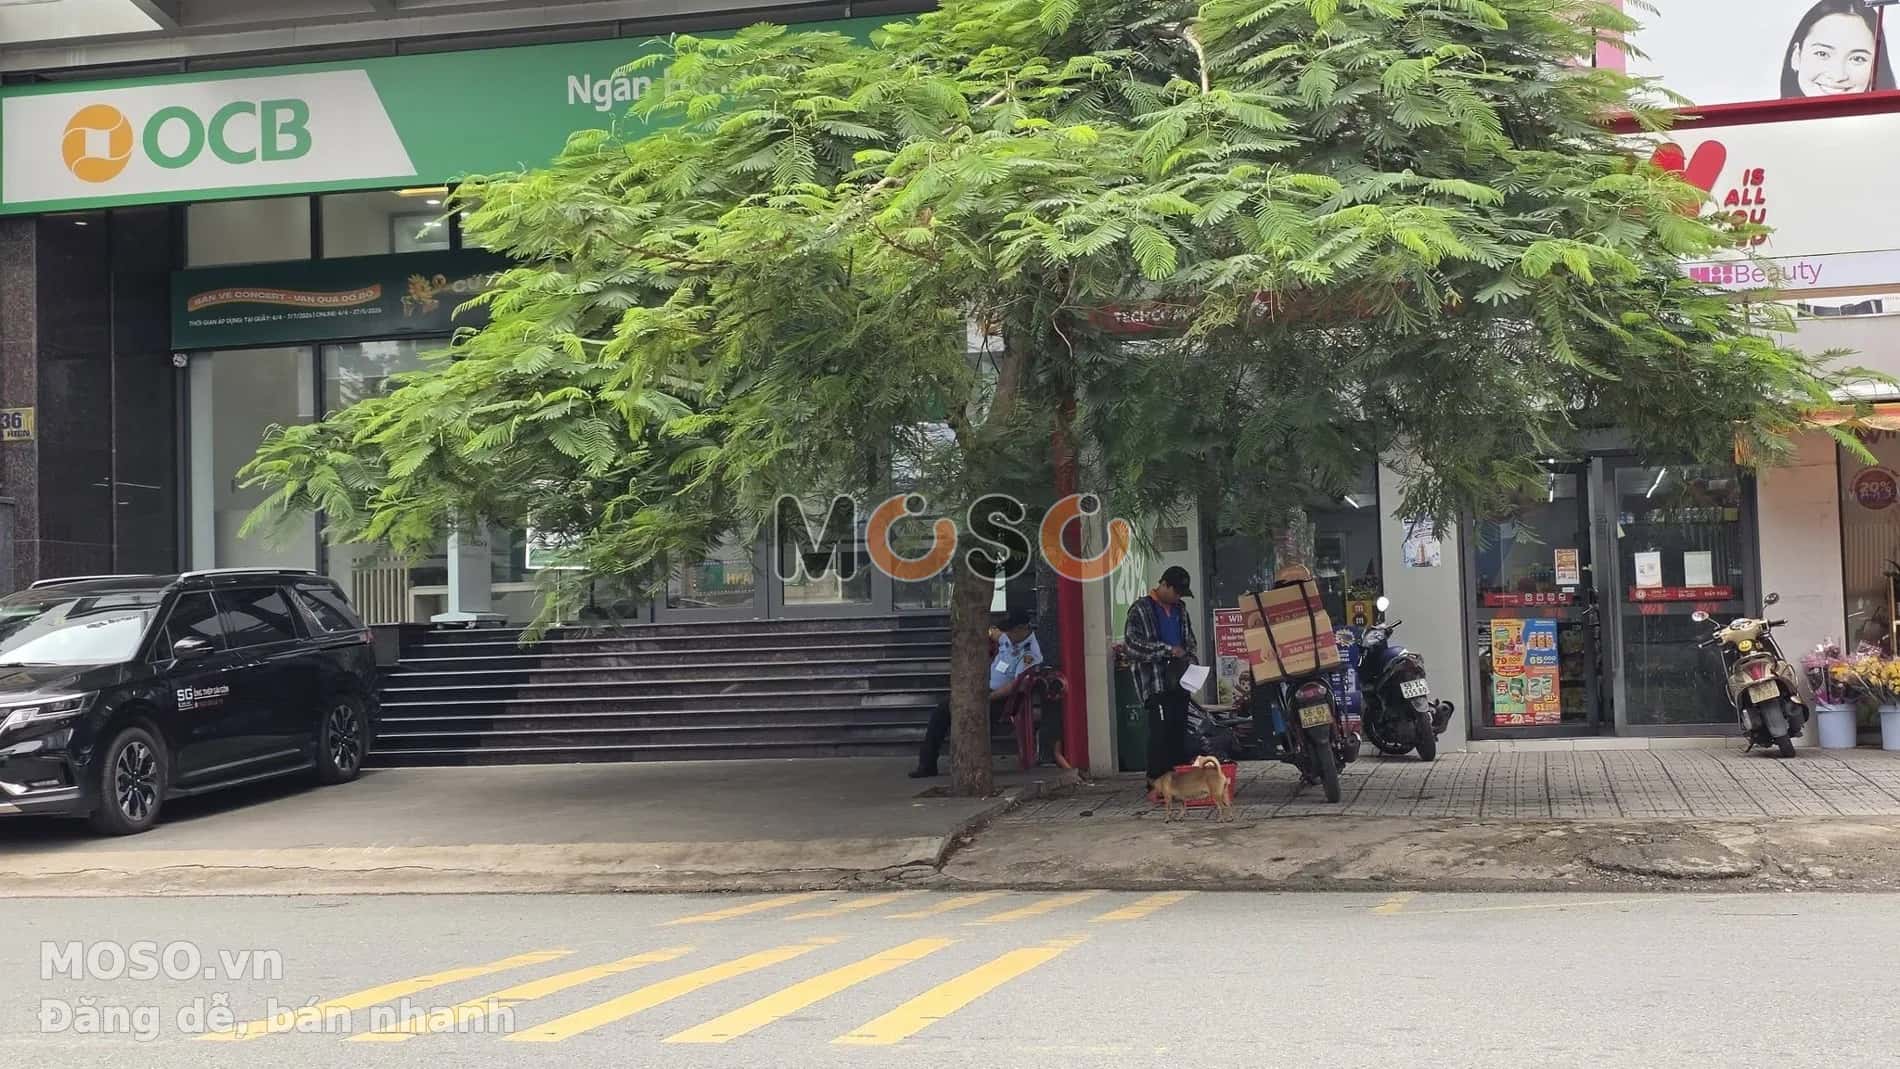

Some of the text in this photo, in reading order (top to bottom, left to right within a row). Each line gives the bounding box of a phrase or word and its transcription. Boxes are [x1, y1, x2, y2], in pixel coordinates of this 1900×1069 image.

[141, 98, 313, 170] OCB
[1742, 168, 1765, 187] IS
[1724, 187, 1766, 207] ALL
[1735, 260, 1823, 285] Beauty
[177, 688, 193, 702] SG
